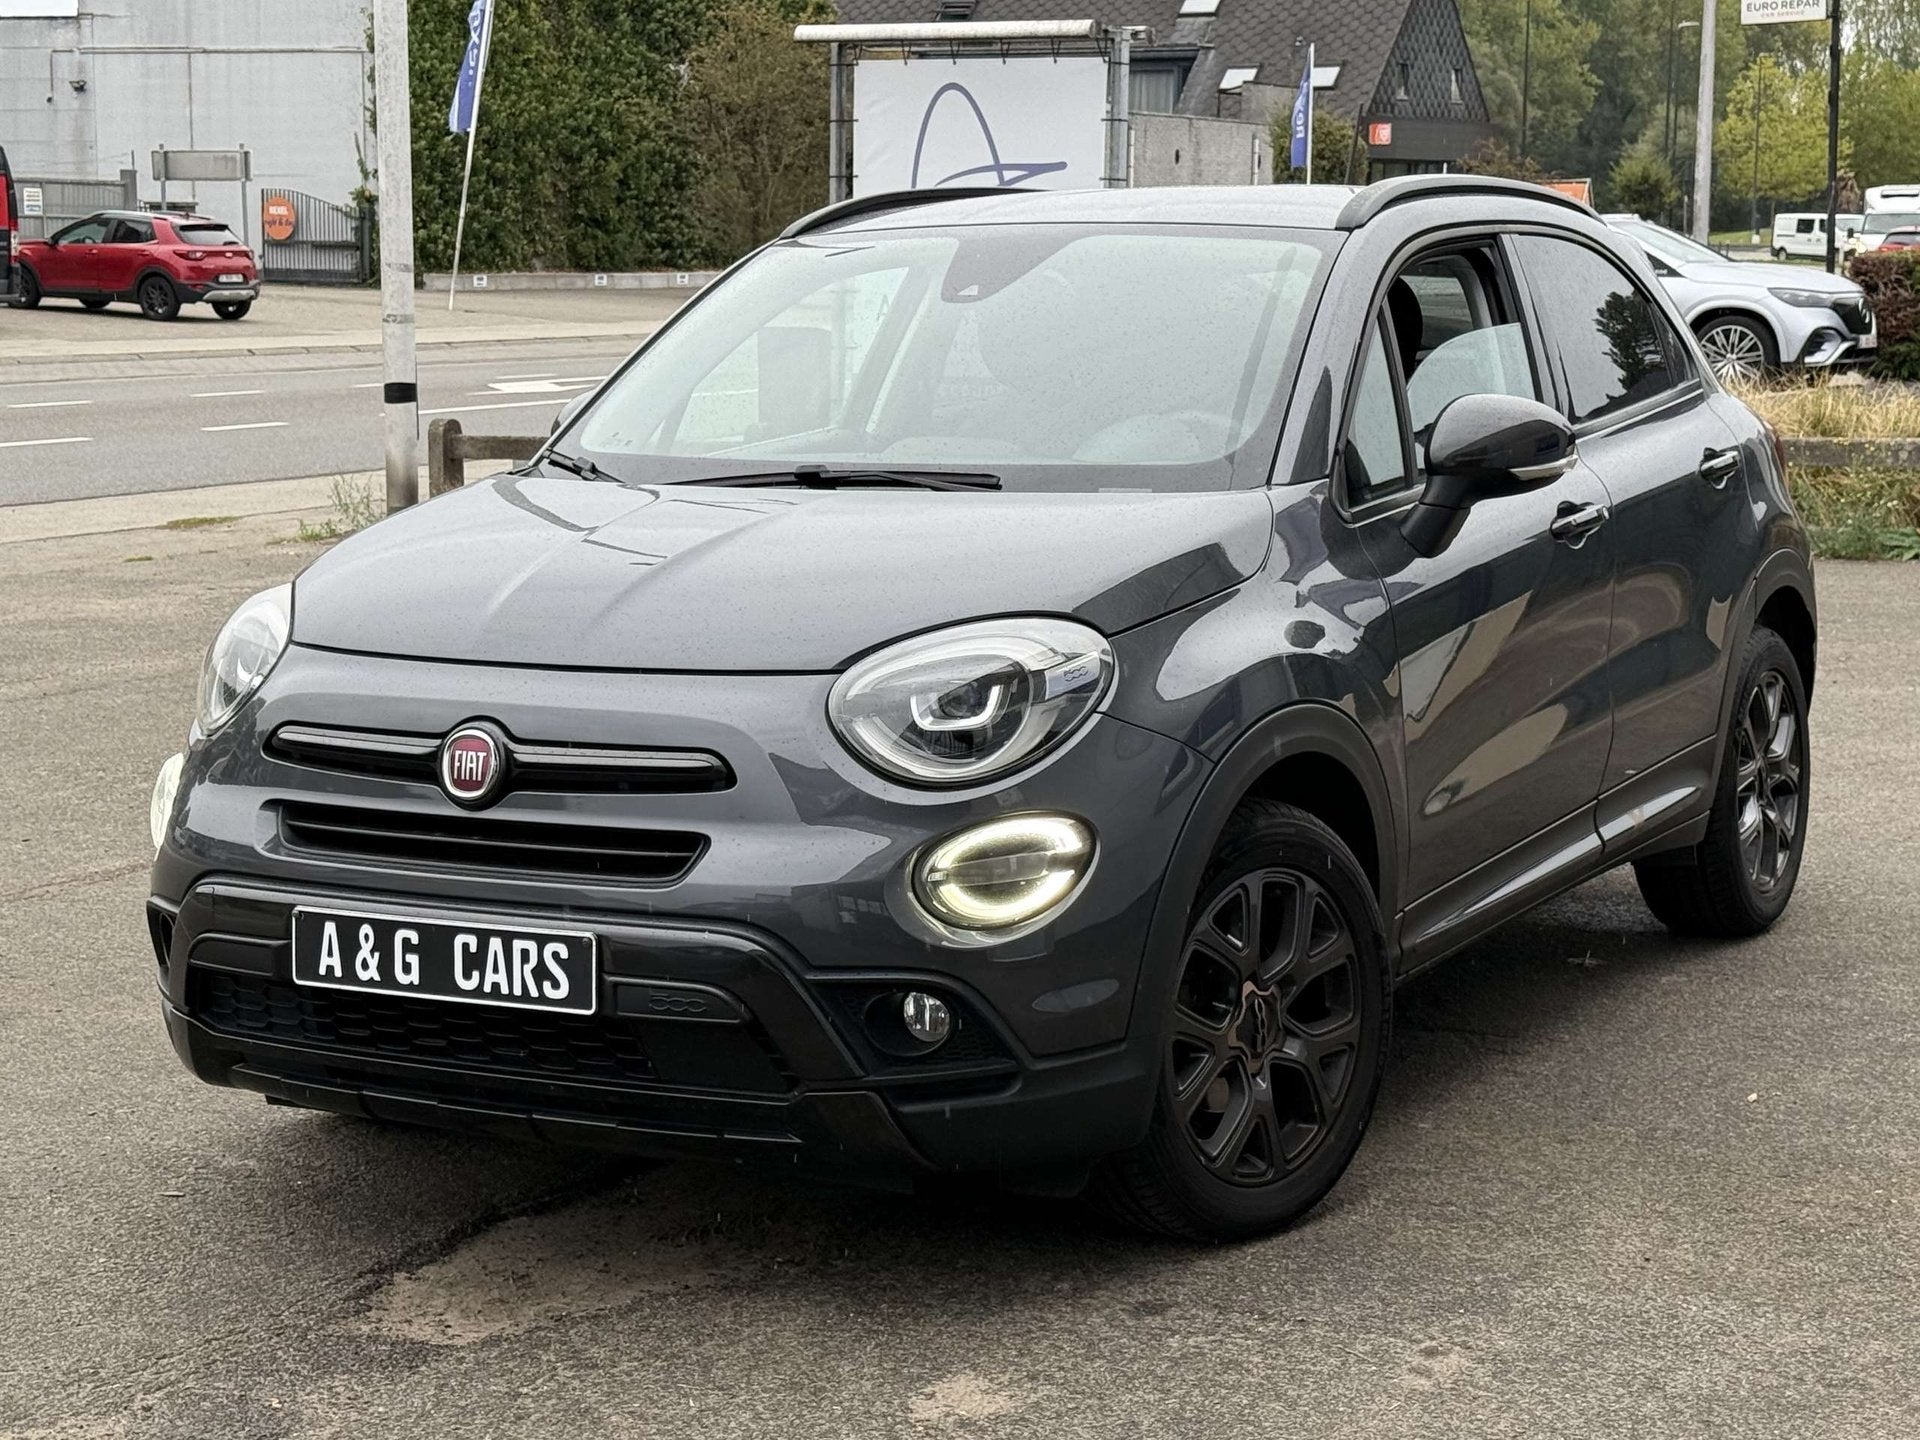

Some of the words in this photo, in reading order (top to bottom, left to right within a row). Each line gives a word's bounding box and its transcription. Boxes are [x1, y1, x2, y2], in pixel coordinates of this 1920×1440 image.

[1746, 1, 1778, 12] EURO
[1780, 0, 1820, 9] REPAR
[453, 750, 488, 782] FIAT
[318, 920, 343, 978] A
[355, 923, 381, 982] &
[394, 928, 420, 986] G
[453, 933, 570, 1000] CARS
